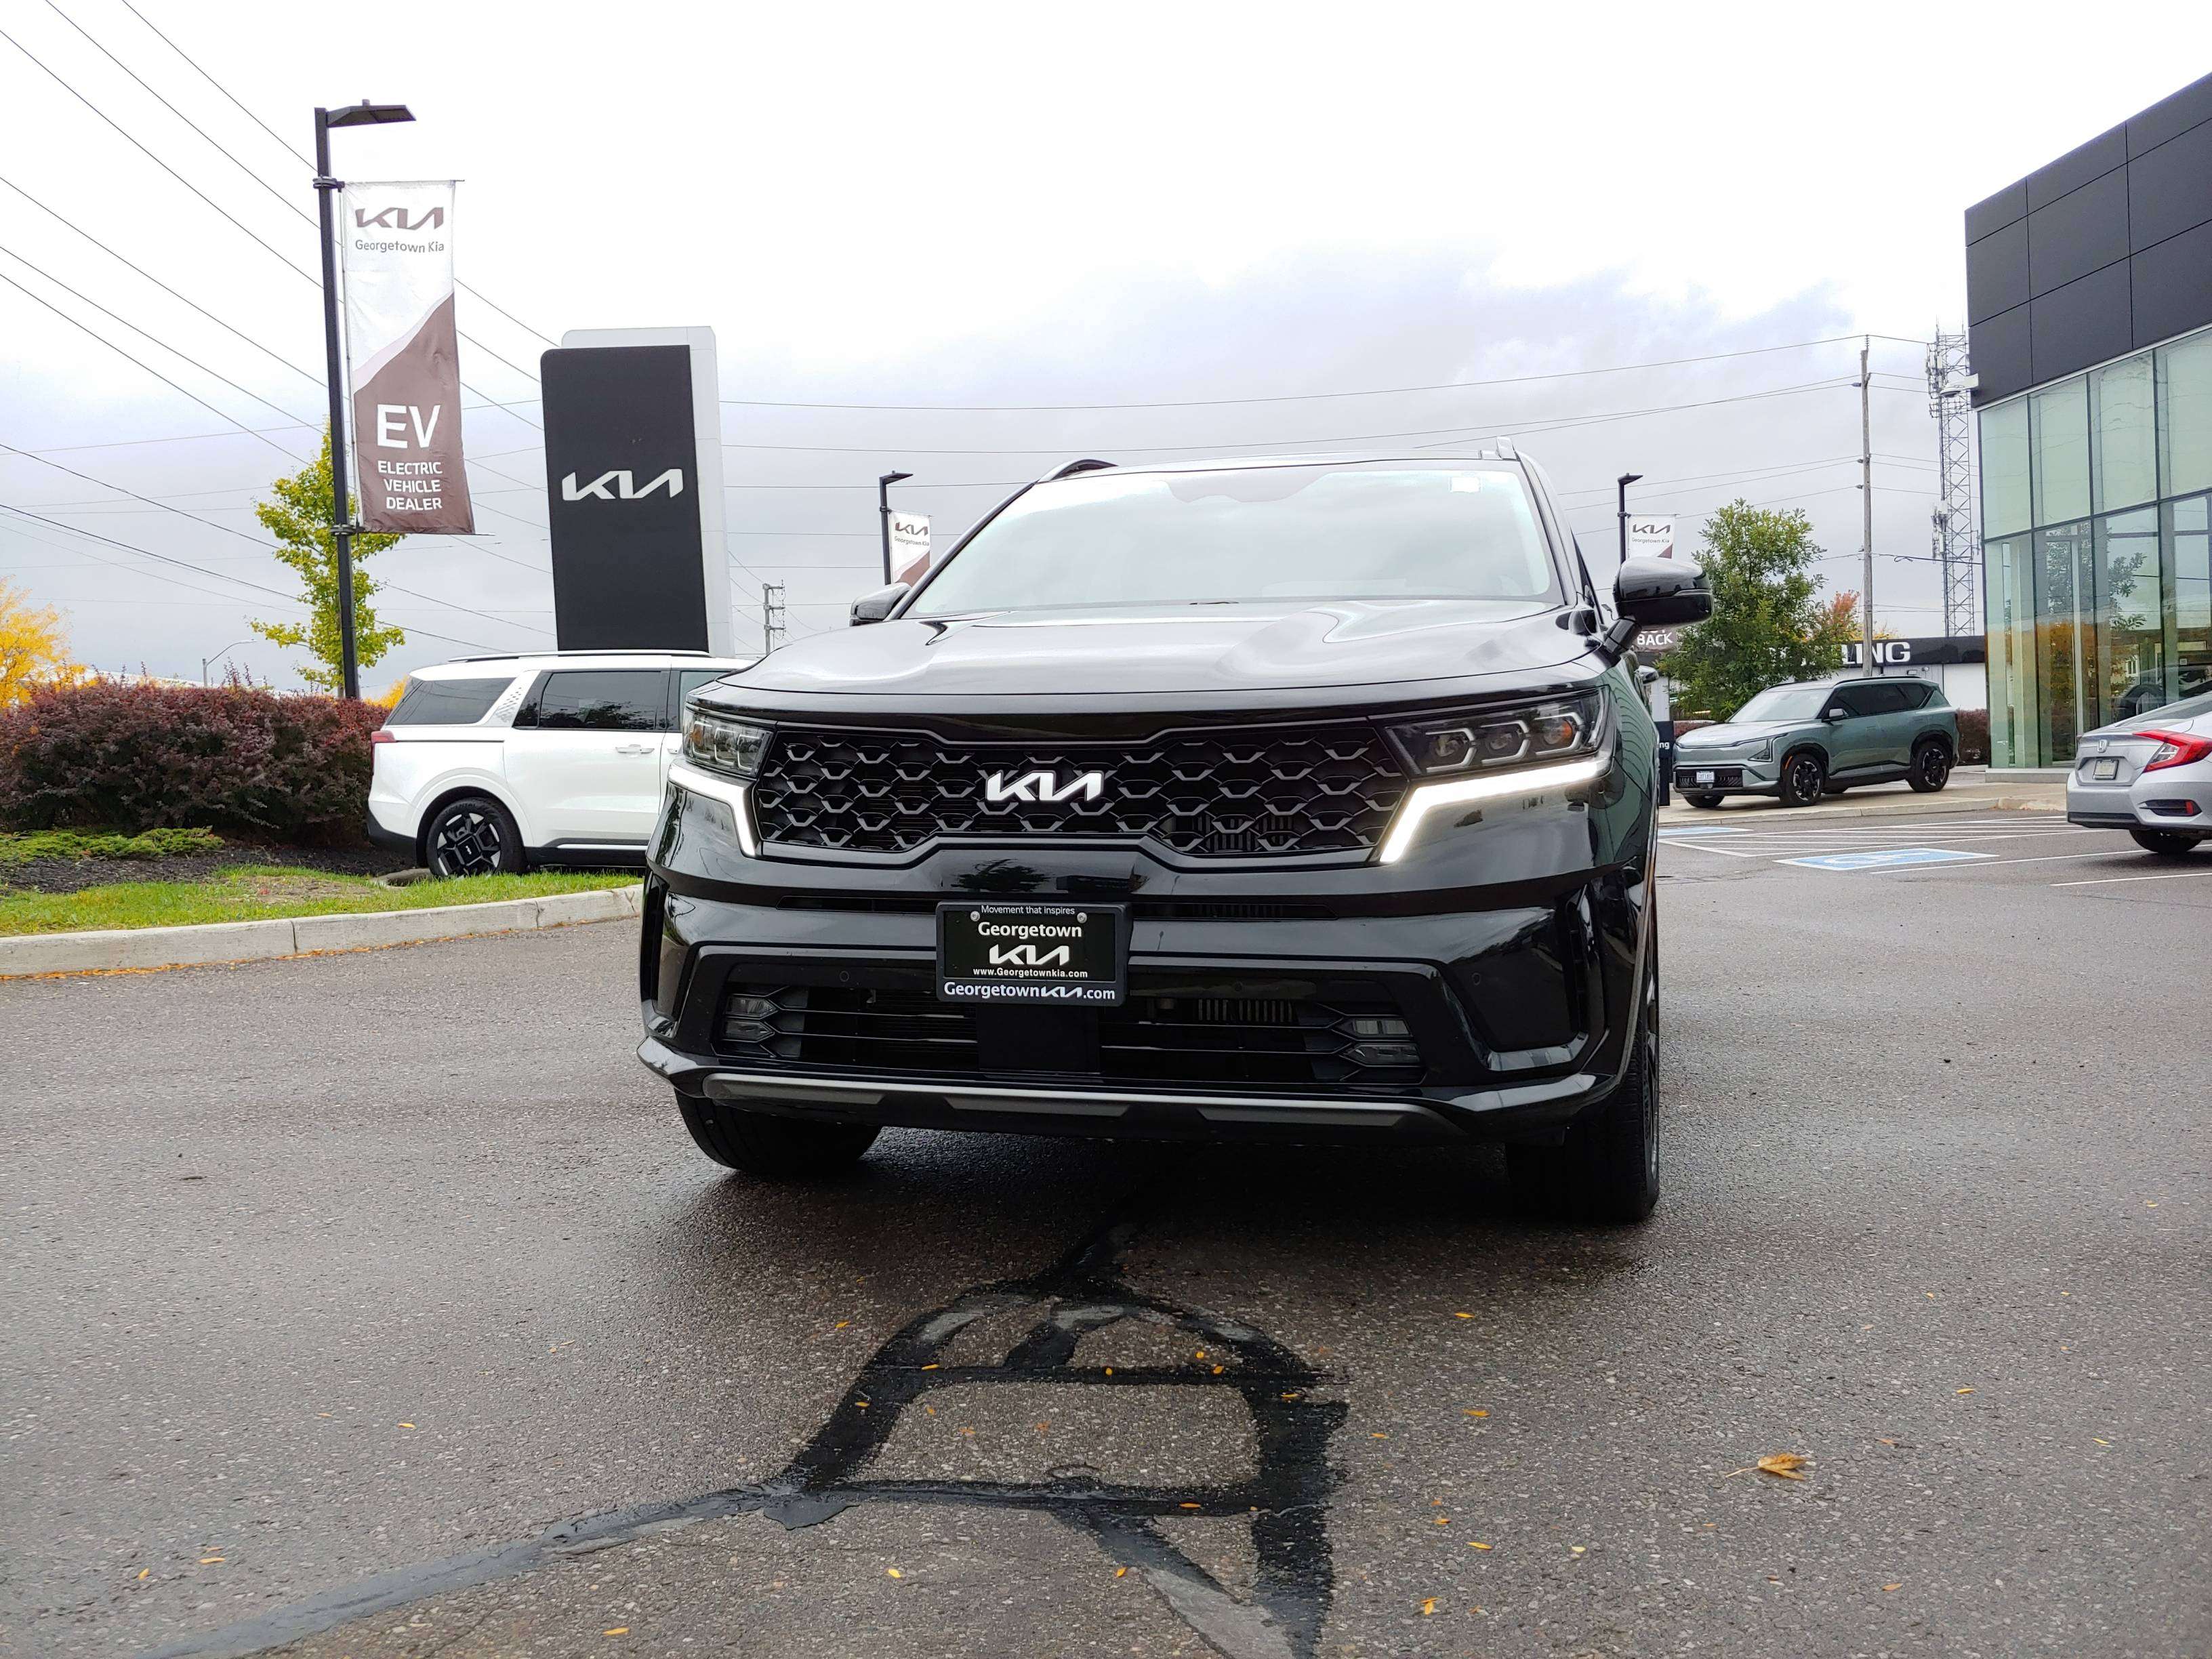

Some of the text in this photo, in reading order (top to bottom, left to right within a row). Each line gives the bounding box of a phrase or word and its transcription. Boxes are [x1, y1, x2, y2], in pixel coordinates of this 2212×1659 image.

[355, 207, 444, 230] KIA
[355, 239, 445, 253] Georgetown Kia
[377, 403, 441, 449] EV
[378, 459, 443, 475] ELECTRIC
[384, 478, 441, 493] VEHICLE
[561, 468, 683, 501] KIA
[386, 497, 443, 511] DEALER
[895, 522, 928, 536] KIA
[1633, 524, 1671, 534] KIA
[1637, 632, 1673, 646] BACK
[985, 770, 1104, 802] KIA
[981, 904, 1075, 916] Movement that inspires
[978, 922, 1082, 939] Georgetown
[989, 944, 1069, 966] KIA
[973, 967, 1088, 979] www.Georgetownkia.com
